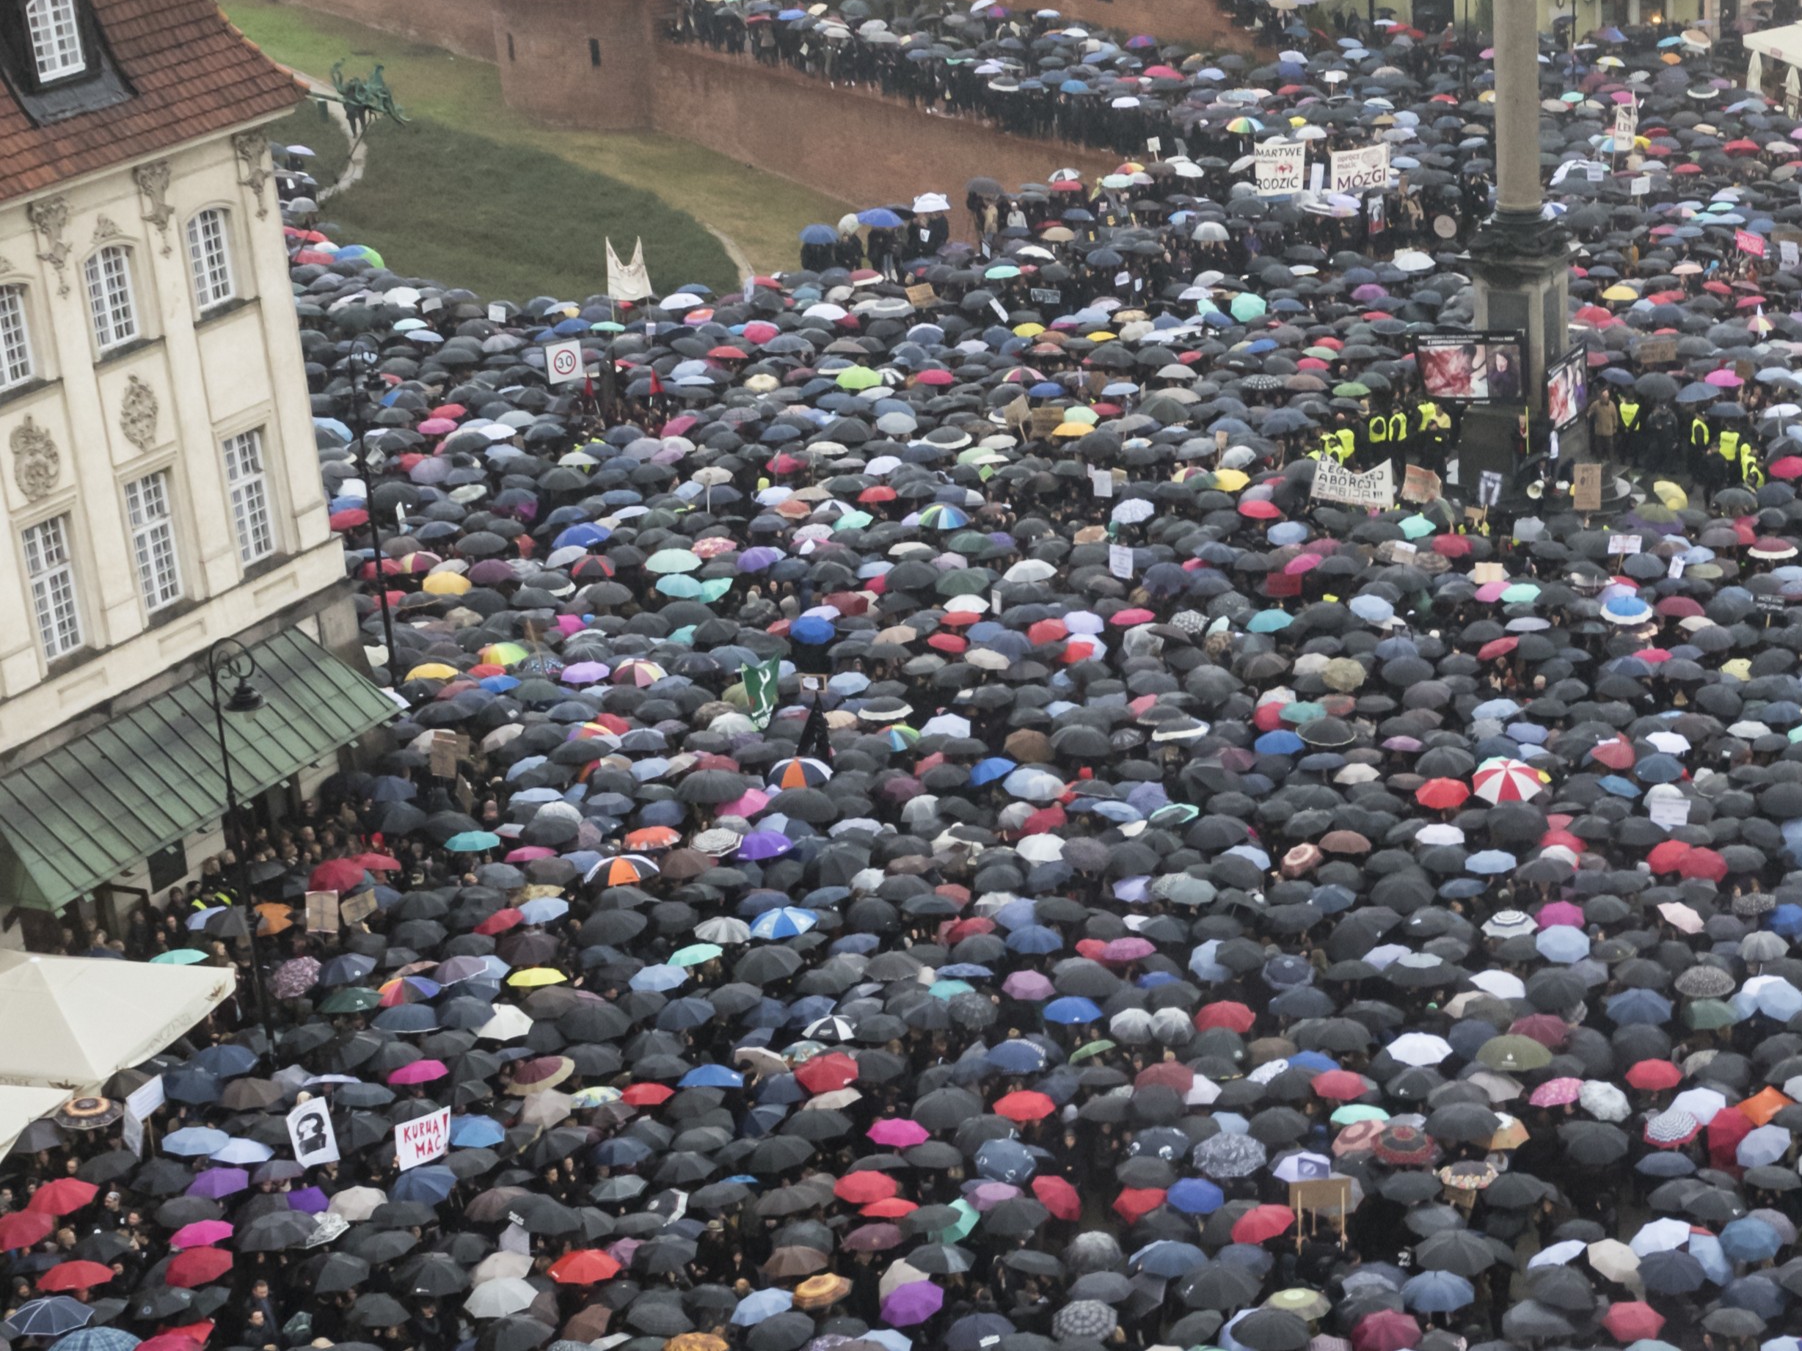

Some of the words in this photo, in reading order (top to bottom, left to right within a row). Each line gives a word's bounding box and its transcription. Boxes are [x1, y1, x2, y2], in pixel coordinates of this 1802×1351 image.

[1255, 146, 1302, 157] MARTWE
[1256, 174, 1299, 190] RODZIĆ
[1337, 169, 1386, 191] MÓZGI
[557, 355, 572, 368] 30
[1318, 473, 1376, 489] ABORCJI
[403, 1118, 440, 1144] KURWA
